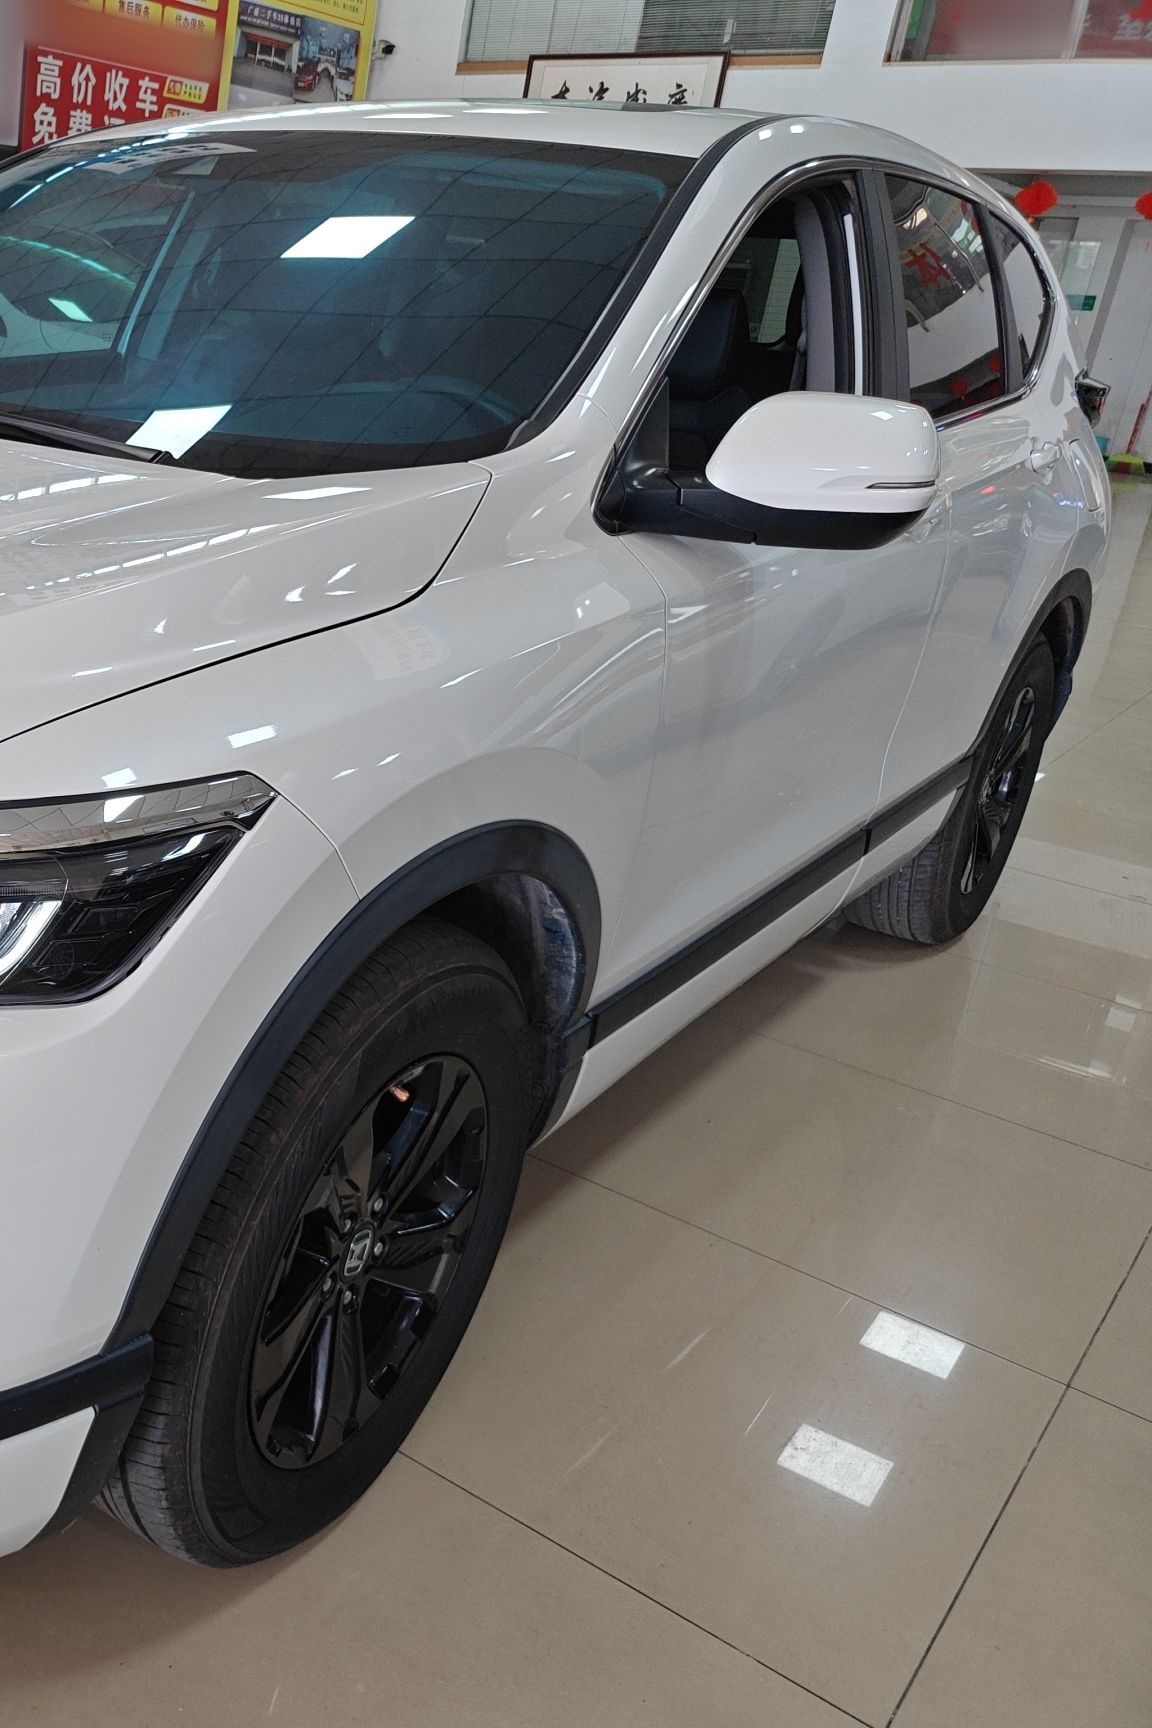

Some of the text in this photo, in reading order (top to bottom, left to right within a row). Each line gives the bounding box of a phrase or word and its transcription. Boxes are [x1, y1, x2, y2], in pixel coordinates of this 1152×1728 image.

[117, 0, 151, 20] 售后服务
[35, 55, 160, 117] 高价收车
